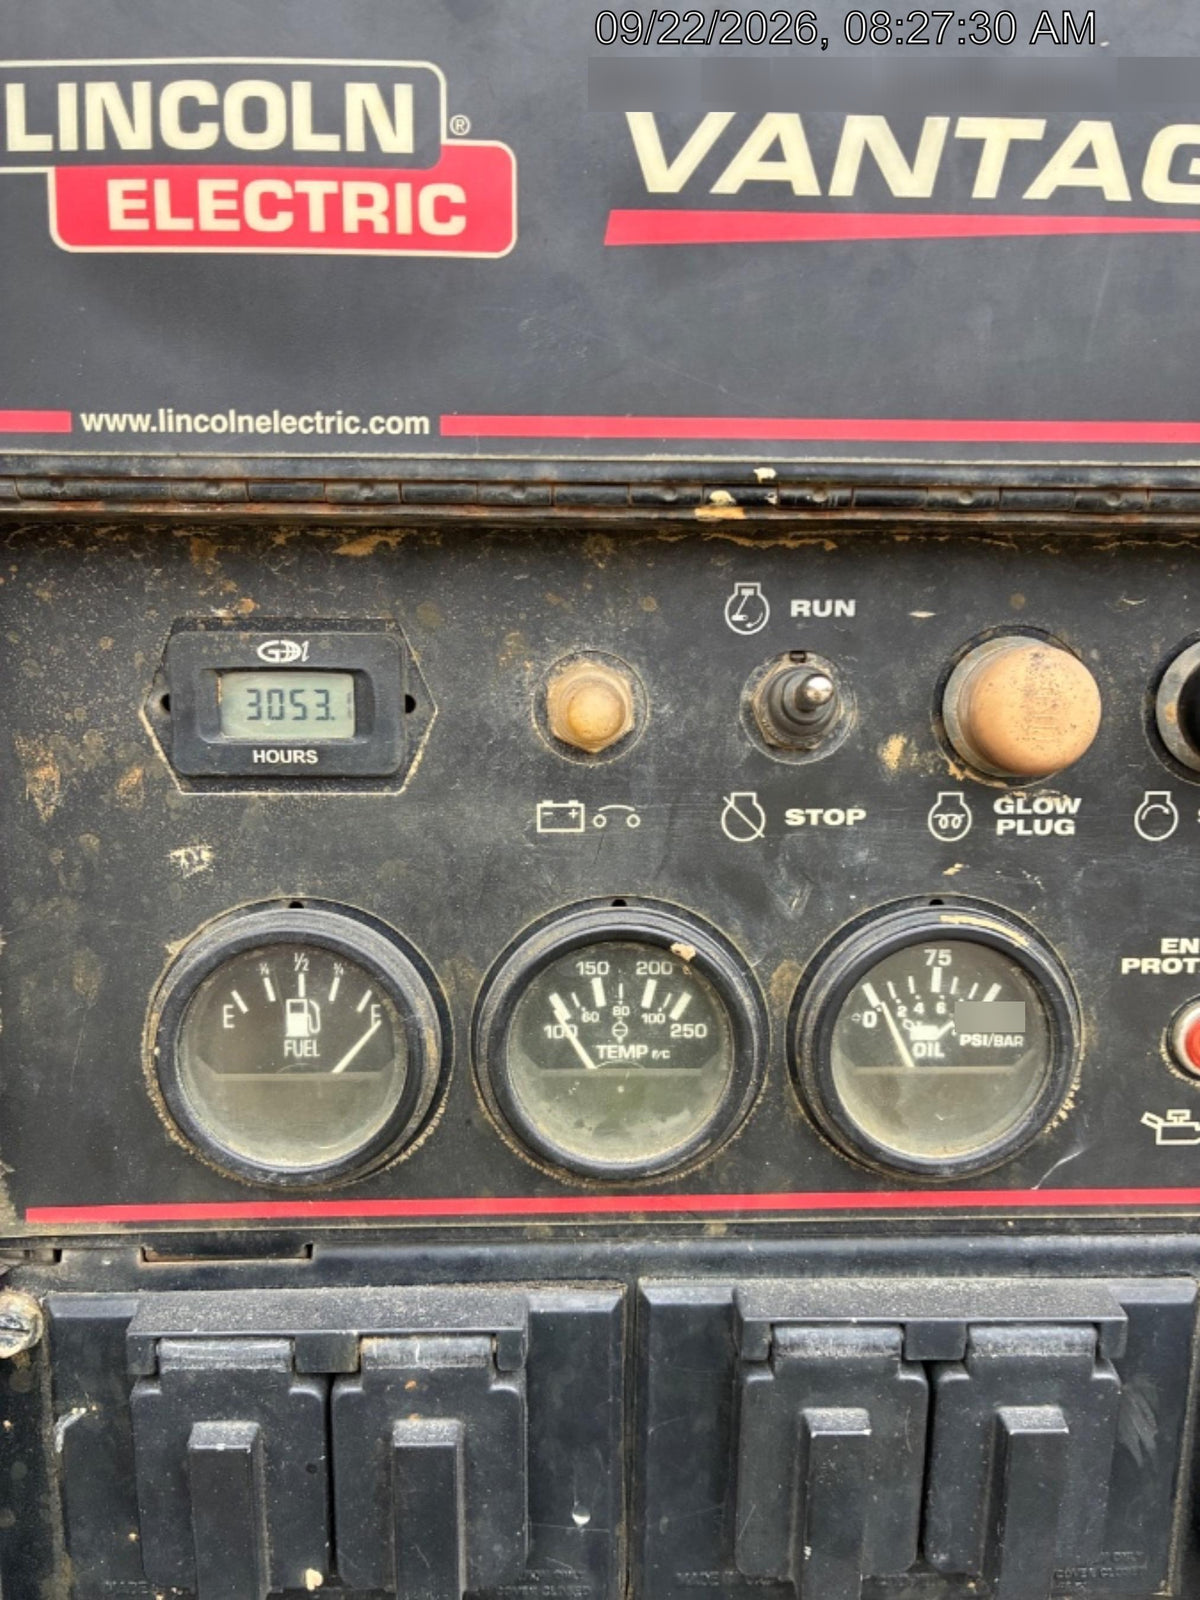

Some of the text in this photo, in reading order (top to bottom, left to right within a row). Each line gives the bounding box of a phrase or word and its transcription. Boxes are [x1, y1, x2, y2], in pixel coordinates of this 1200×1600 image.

[5, 80, 414, 154] LINCOLN
[107, 178, 467, 236] ELECTRIC
[80, 409, 430, 435] www.lincolnelectric.com
[790, 599, 856, 618] RUN
[252, 749, 319, 765] HOURS
[993, 797, 1082, 816] GLOW
[784, 808, 867, 827] STOP
[996, 818, 1076, 837] PLUG
[1160, 938, 1200, 954] EN
[924, 949, 952, 966] 75
[1121, 957, 1200, 975] PROT
[575, 961, 673, 976] 150 200
[223, 1004, 235, 1028] E
[641, 1012, 666, 1024] 100
[897, 1001, 947, 1018] 2 4 6
[543, 1024, 708, 1039] 100 250
[283, 1039, 321, 1057] FUEL
[959, 1032, 1024, 1049] PSI/BAR
[596, 1044, 648, 1060] TEMP
[912, 1041, 945, 1058] OIL
